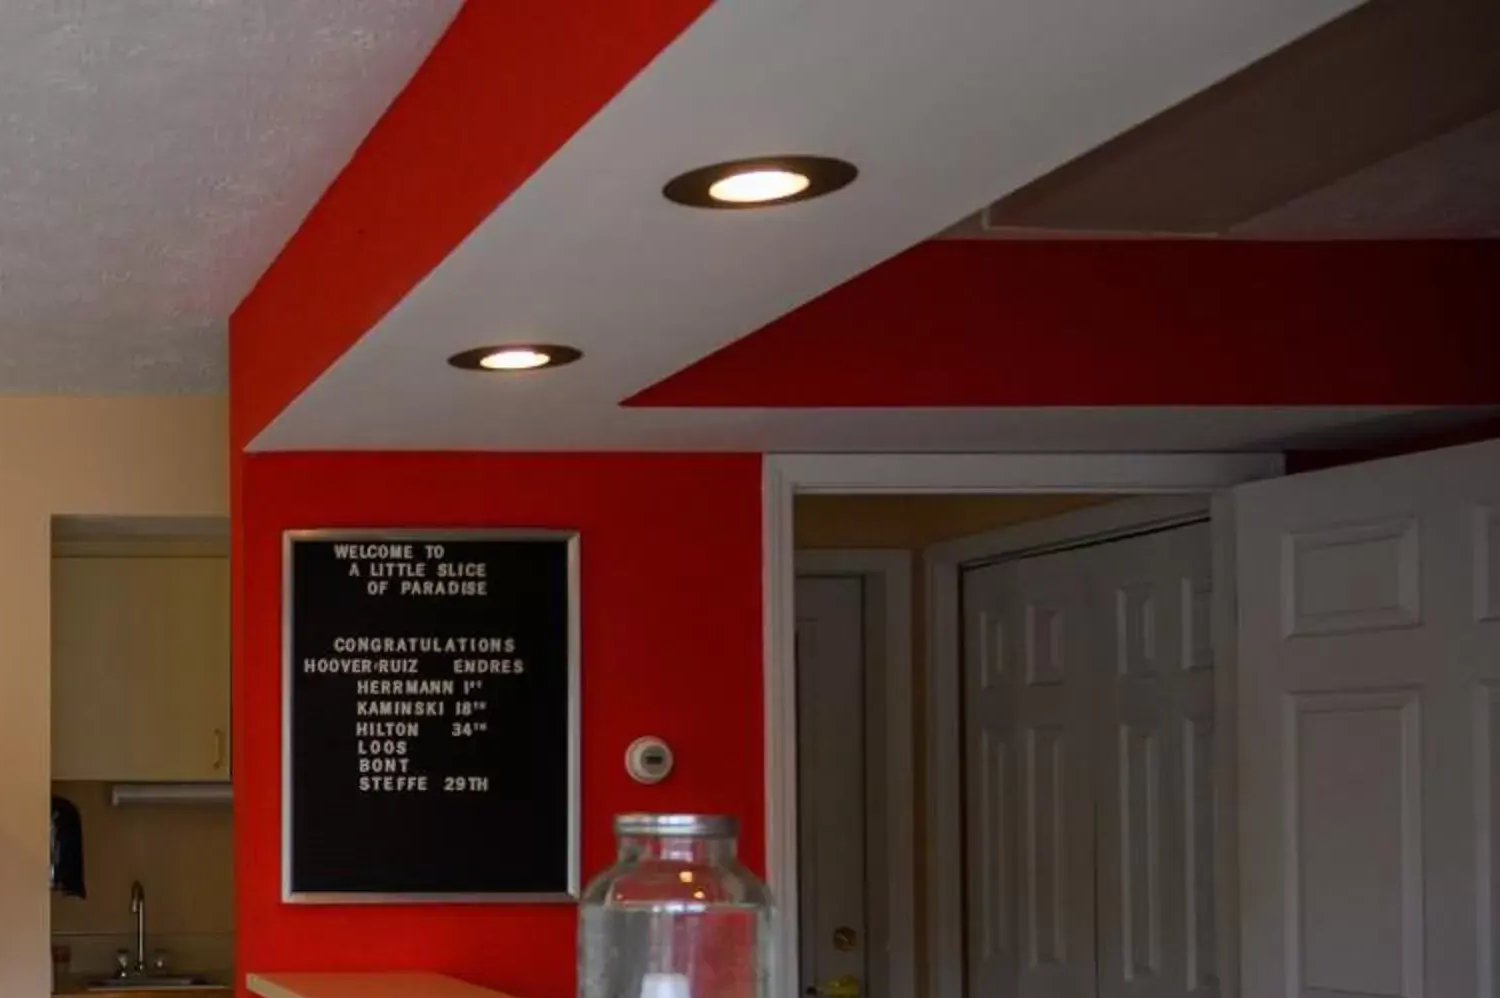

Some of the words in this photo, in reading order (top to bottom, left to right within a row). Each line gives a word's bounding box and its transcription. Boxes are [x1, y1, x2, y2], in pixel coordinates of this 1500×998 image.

[334, 544, 413, 559] WELCOME
[425, 544, 445, 559] TO
[349, 562, 360, 577] A
[370, 562, 426, 577] LITTLE
[437, 562, 487, 577] SLICE
[367, 580, 389, 596] OF
[401, 580, 487, 596] PARADISE
[333, 637, 515, 653] CONGRATULATIONS
[453, 658, 524, 674] ENDRES
[357, 679, 454, 695] HERRMANN
[357, 700, 444, 716] KAMINSKI
[355, 721, 419, 737] HILTON
[357, 739, 407, 755] LOOS
[359, 757, 409, 773] BONT
[359, 775, 427, 792] STEFFE
[444, 776, 489, 792] 29TH
